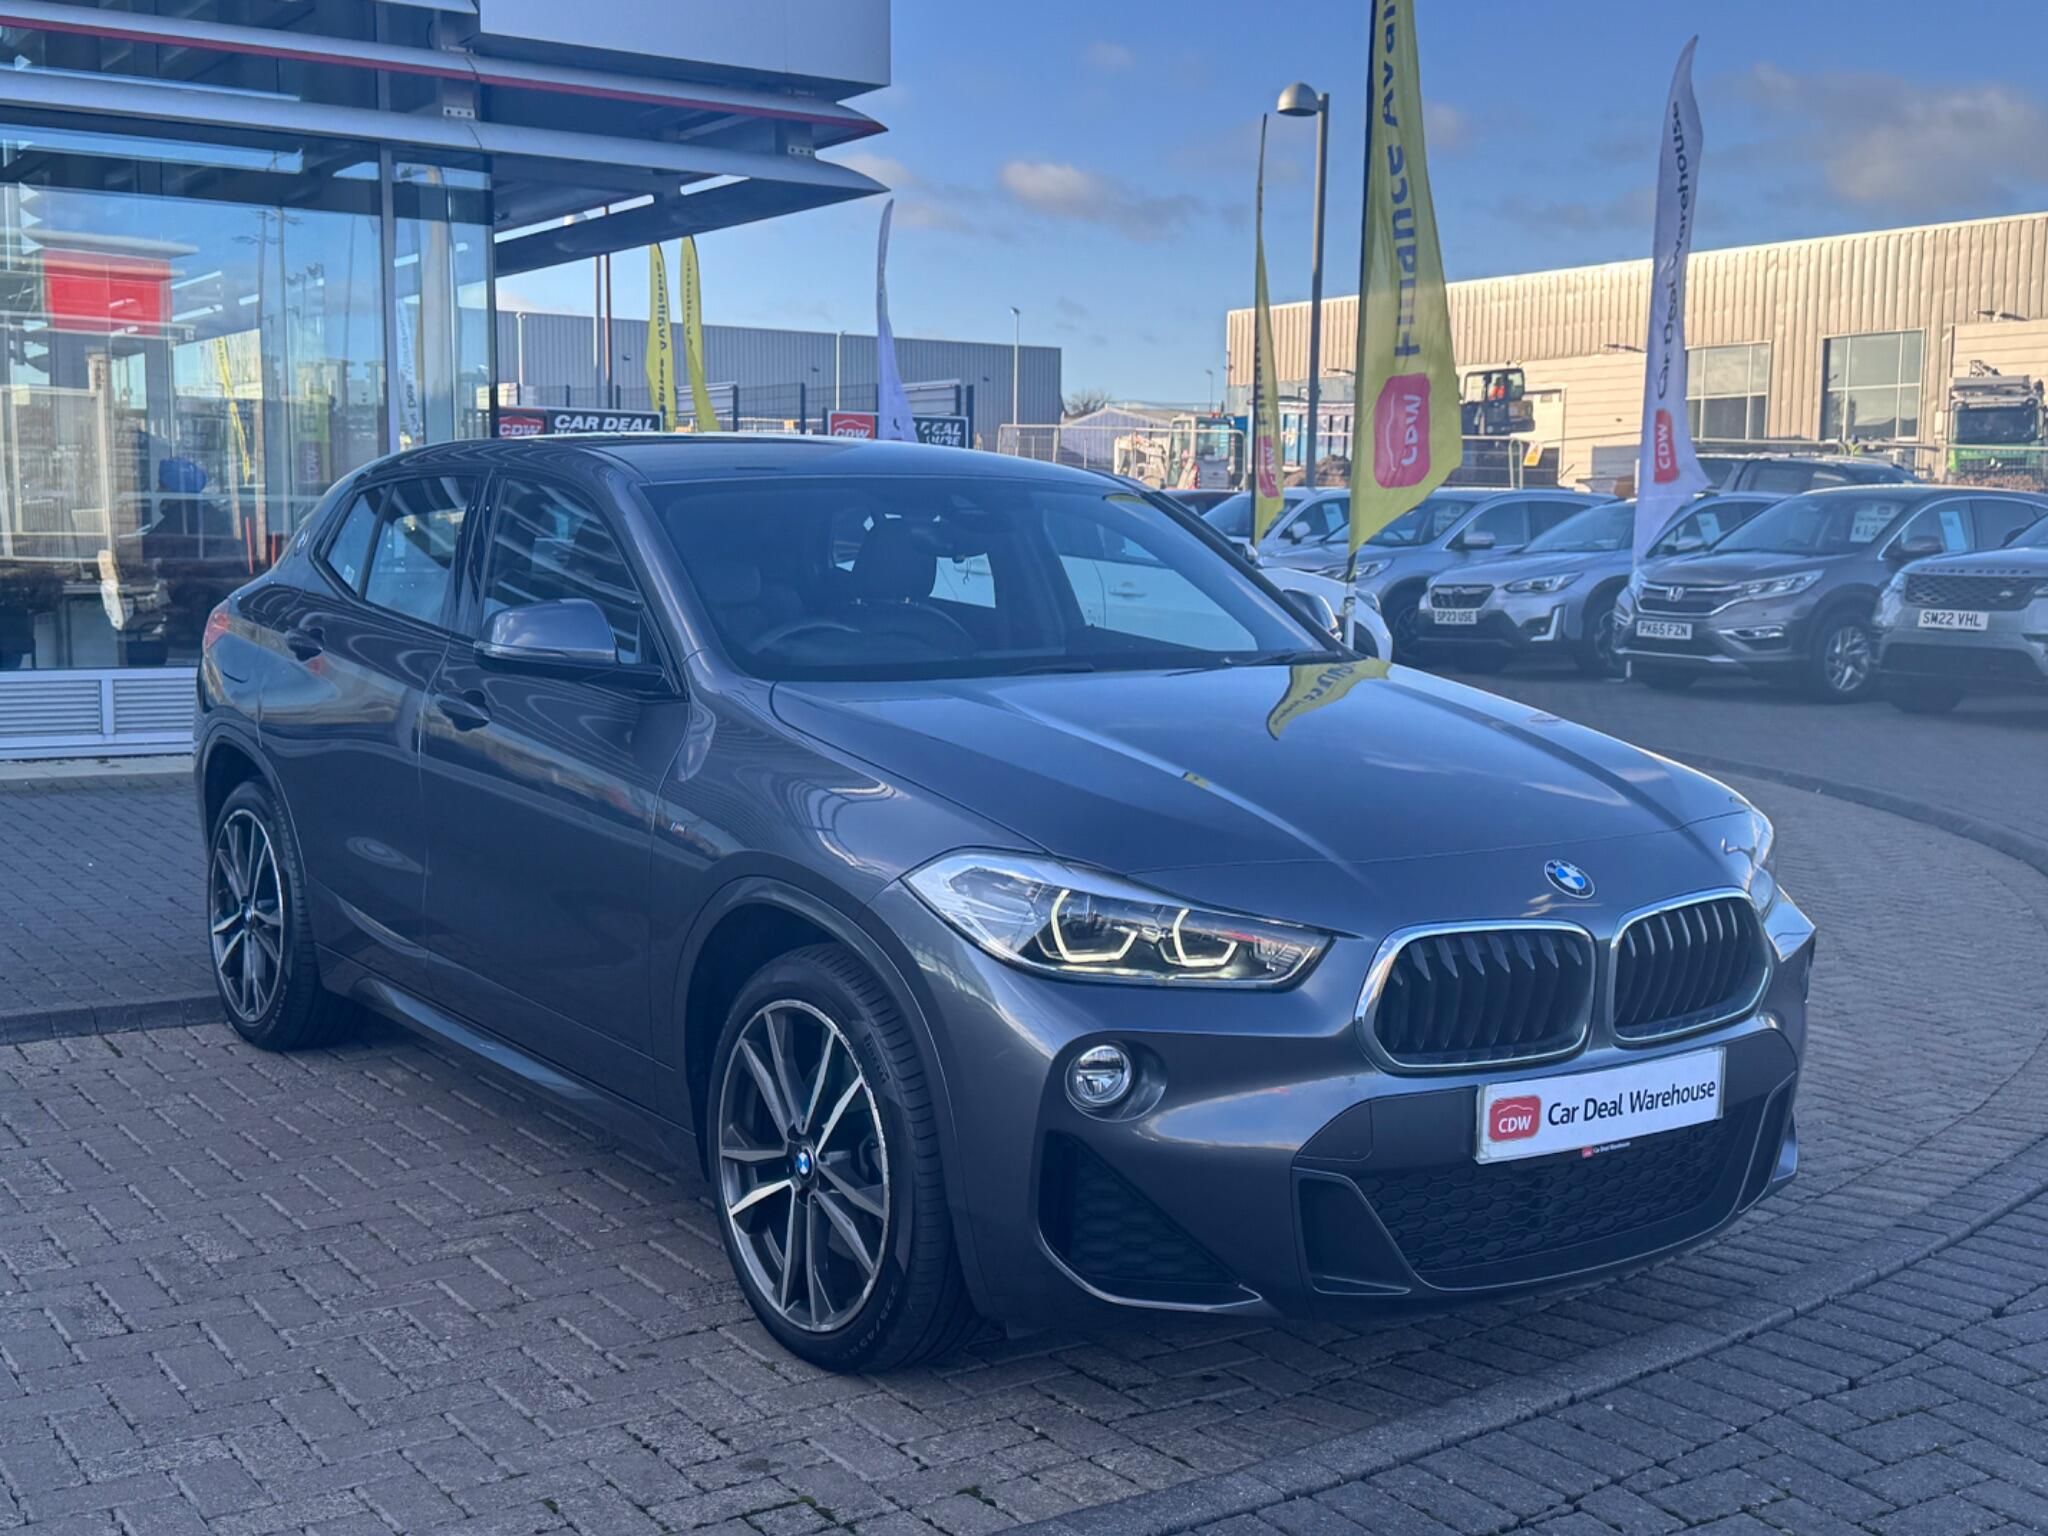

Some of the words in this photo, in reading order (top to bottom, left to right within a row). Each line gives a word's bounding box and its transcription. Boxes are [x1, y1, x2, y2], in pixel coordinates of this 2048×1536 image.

[1381, 0, 1399, 127] Avai
[1666, 97, 1691, 270] Warehouse
[498, 423, 541, 437] CDW
[554, 414, 601, 431] CAR
[603, 416, 655, 432] DEAL
[833, 427, 871, 440] CDW
[1656, 424, 1672, 469] CDW
[1640, 621, 1665, 635] PK65
[1667, 624, 1688, 637] FZN
[1958, 613, 1982, 627] VHL
[1548, 1102, 1580, 1126] Car
[1583, 1097, 1624, 1122] Deal
[1629, 1080, 1717, 1113] Warehouse
[1498, 1115, 1532, 1135] CDW
